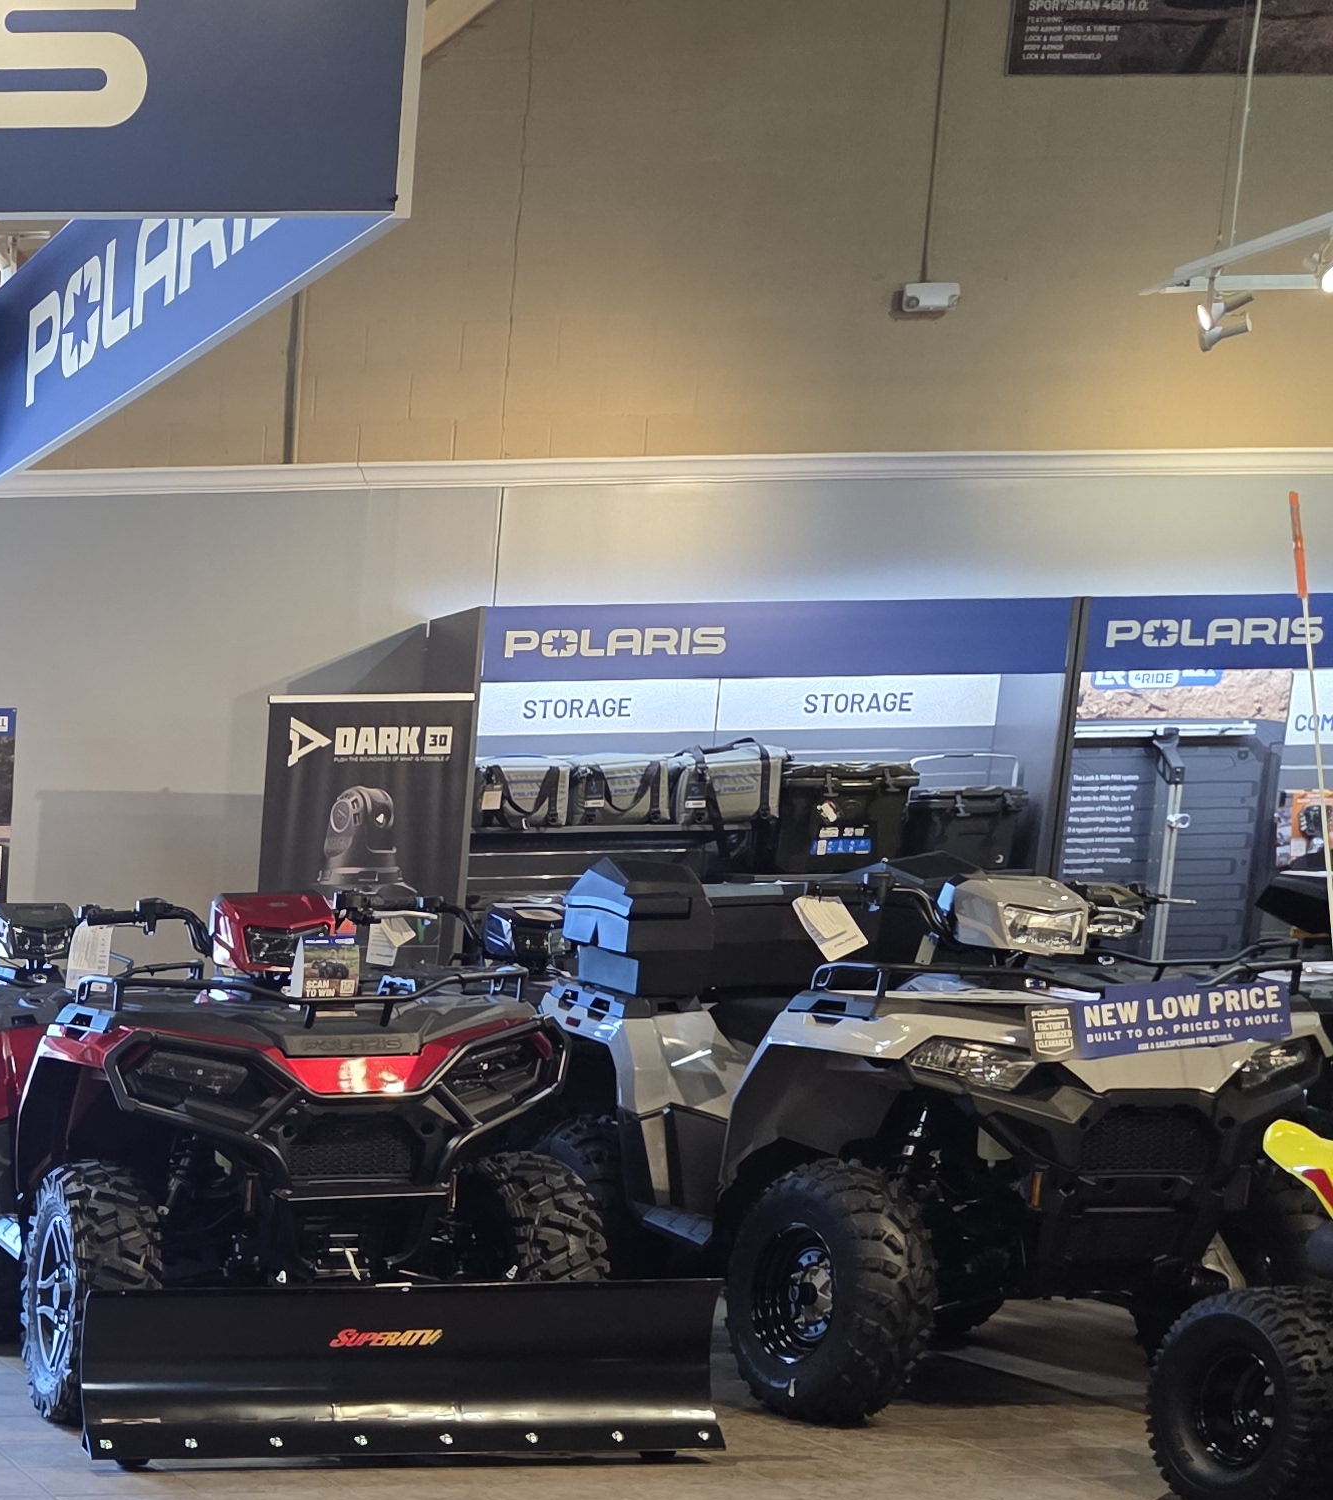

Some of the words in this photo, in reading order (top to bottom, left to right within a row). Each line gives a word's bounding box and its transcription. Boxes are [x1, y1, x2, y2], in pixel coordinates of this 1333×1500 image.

[1029, 0, 1100, 11] SPORTSMAN
[1105, 616, 1324, 648] POLARIS
[504, 626, 727, 658] POLARIS
[521, 697, 633, 720] STORAGE
[802, 691, 913, 714] STORAGE
[334, 726, 421, 755] DARK
[428, 734, 448, 747] 30
[306, 980, 330, 989] SCAN
[306, 988, 317, 997] TO
[318, 988, 336, 997] WIN
[1031, 1008, 1069, 1017] POLARIS
[1083, 1000, 1139, 1028] NEW
[1146, 993, 1201, 1021] LOW
[1208, 985, 1282, 1014] PRICE
[1038, 1021, 1065, 1031] FACTORY
[1086, 1029, 1121, 1043] BUILT
[1126, 1028, 1142, 1038] TO
[1173, 1021, 1220, 1034] PRICED
[1224, 1018, 1240, 1028] TO
[1245, 1013, 1284, 1025] MOVE.
[302, 1037, 402, 1052] POLARIS
[1038, 1038, 1070, 1048] CLEARANCE
[1155, 1038, 1195, 1049] SALESPERSON
